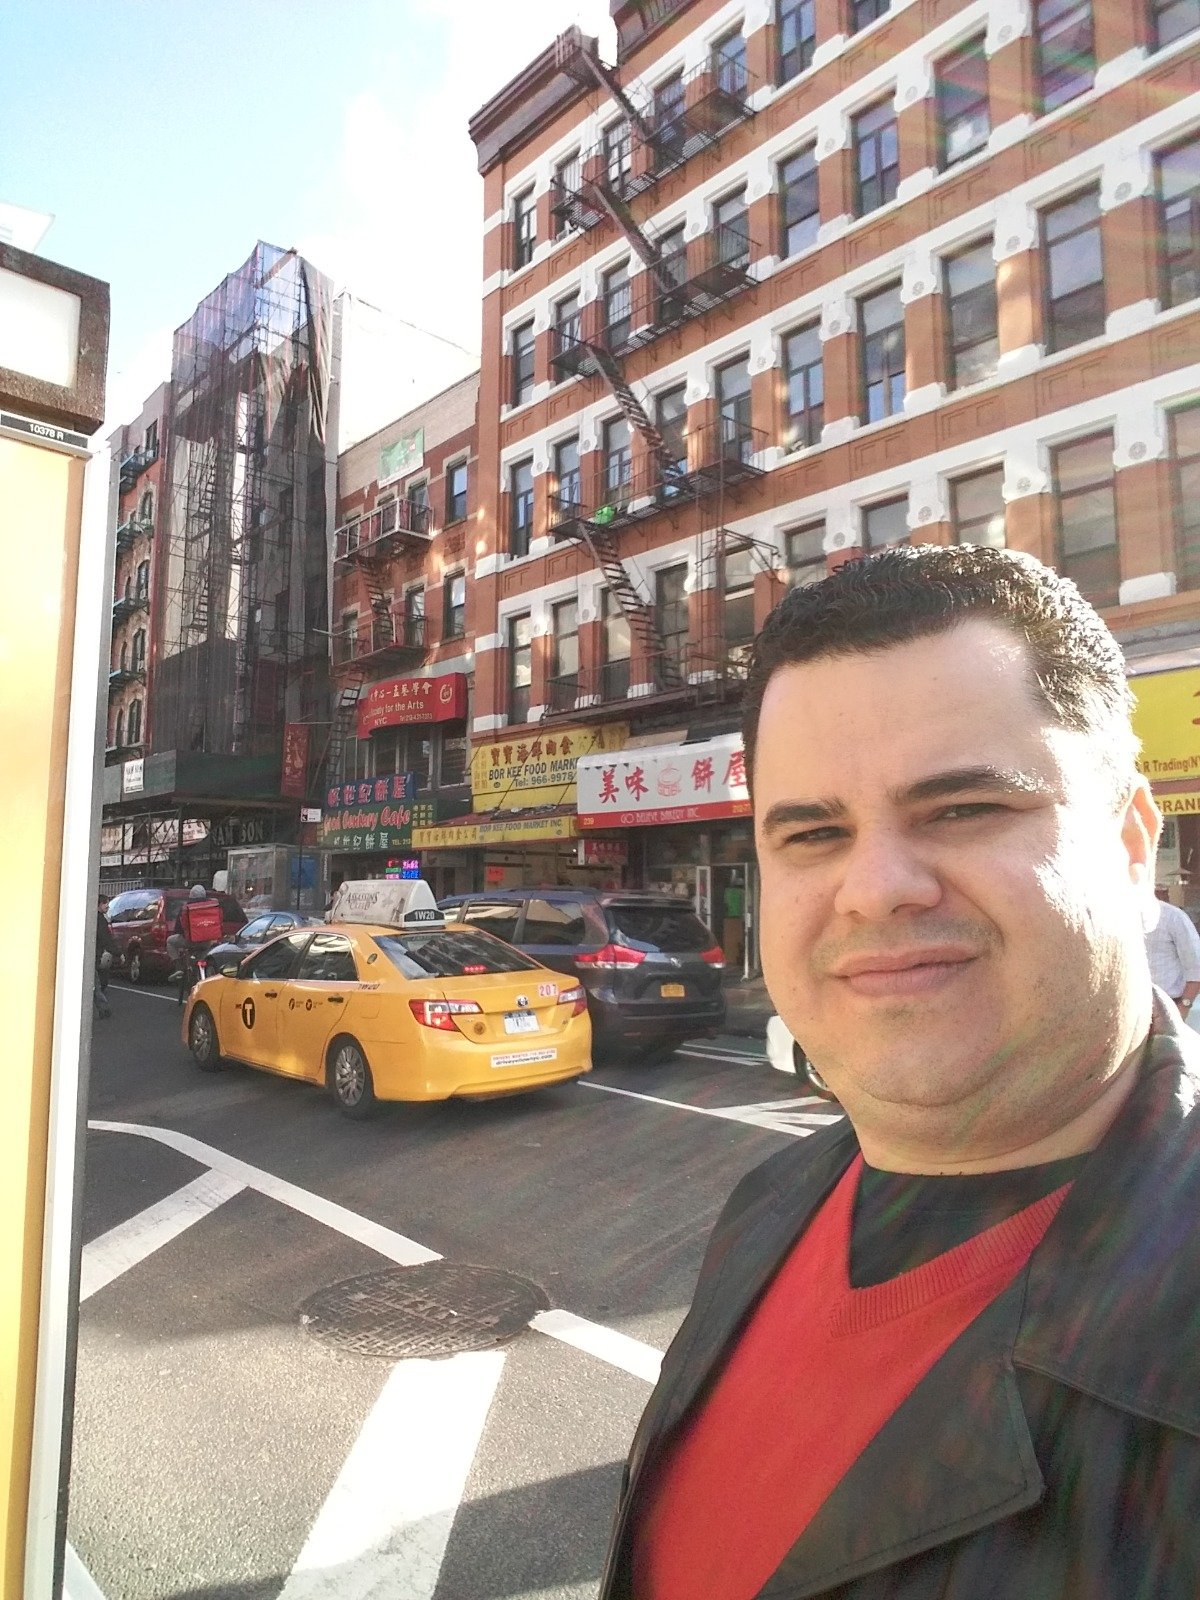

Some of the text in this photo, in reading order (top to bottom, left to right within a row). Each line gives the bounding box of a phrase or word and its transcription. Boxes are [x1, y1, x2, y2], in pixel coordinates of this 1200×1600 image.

[29, 423, 64, 441] 10378 R
[395, 702, 406, 712] the
[407, 700, 424, 710] Arts
[374, 716, 388, 726] NYC
[489, 768, 505, 781] BOR
[506, 766, 523, 779] KEE
[524, 762, 547, 776] FOOD
[1143, 761, 1151, 773] R
[514, 771, 574, 788] Tel: 966-9978
[599, 751, 748, 804] 美味 餅屋
[342, 809, 378, 832] Century
[380, 804, 411, 830] Cafe
[583, 817, 595, 826] 239
[620, 813, 635, 824] GO
[479, 825, 492, 833] BOR
[493, 824, 504, 832] KEE
[505, 823, 521, 831] FOOD
[523, 820, 549, 830] MARKET
[414, 910, 435, 920] 1W20
[539, 984, 557, 996] 207
[244, 1003, 253, 1026] T
